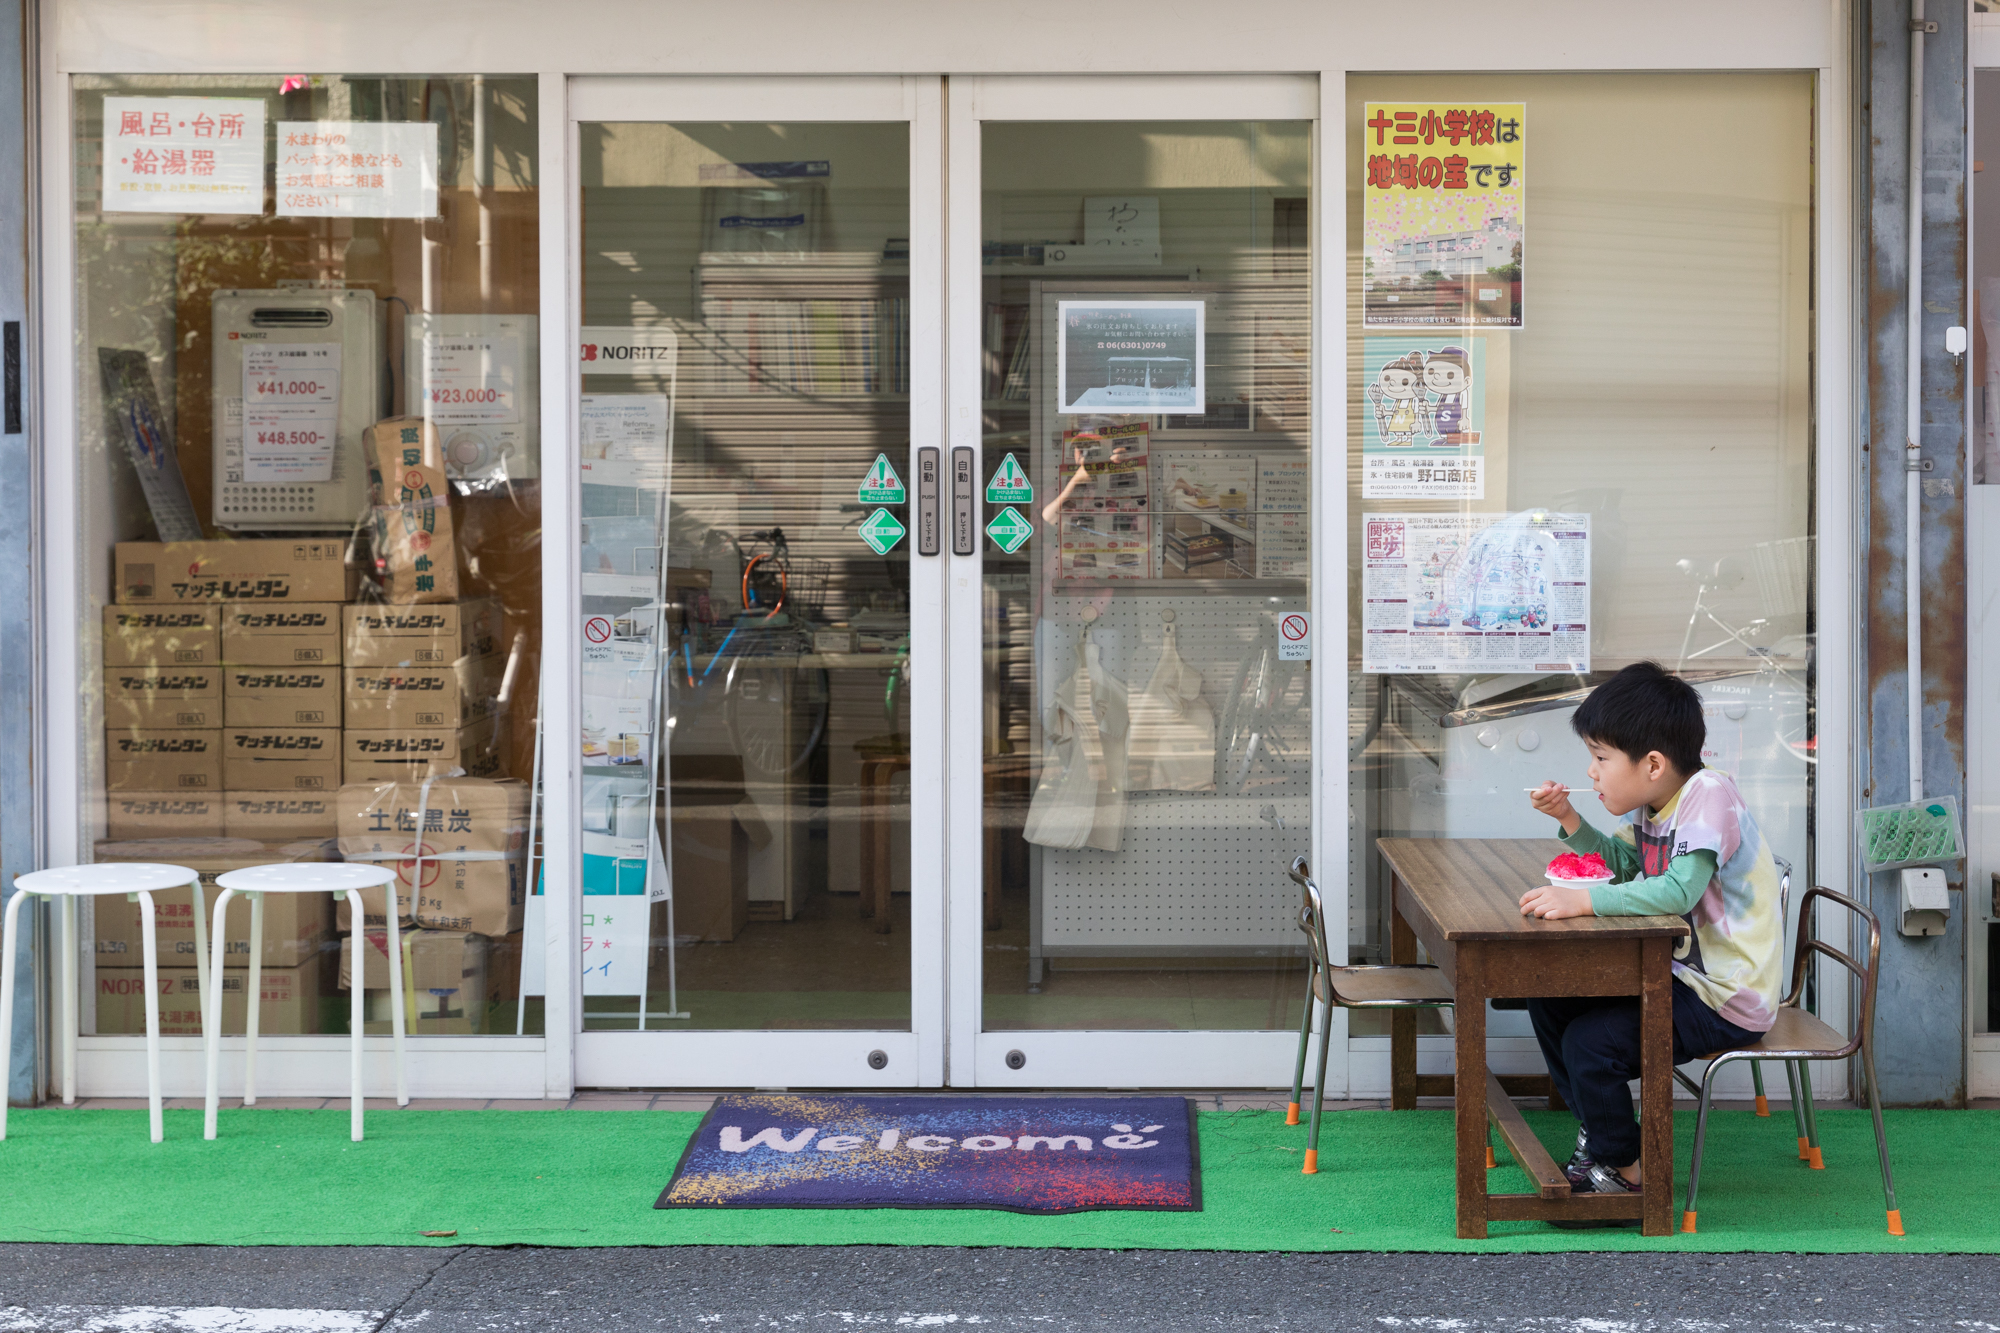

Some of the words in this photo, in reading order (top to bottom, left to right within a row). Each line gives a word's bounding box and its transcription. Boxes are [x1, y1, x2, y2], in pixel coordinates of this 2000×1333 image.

[119, 110, 245, 139] 風呂・台所
[1367, 109, 1521, 147] 十三小学校は
[285, 132, 346, 147] 水まわりの
[284, 153, 403, 168] パッキン交換なども
[1367, 153, 1518, 190] 地域の宝です
[285, 173, 385, 188] お気軽にご相談
[1106, 341, 1167, 350] 06(6301)0749
[602, 346, 668, 360] NORITZ
[1440, 410, 1452, 421] S
[1370, 459, 1434, 467] 台所・風呂・給湯器
[923, 460, 934, 483] 自動
[957, 460, 968, 483] 自動
[1370, 471, 1413, 479] 氷・住宅設備
[1417, 468, 1477, 483] 野口商店
[1370, 524, 1382, 550] 関西
[171, 579, 290, 598] マッチレンタン
[116, 614, 205, 627] マッチレンタン
[237, 613, 327, 627] マッチレンタン
[356, 615, 446, 629] マッチレンタン
[119, 676, 209, 690] マッチレンタン
[236, 675, 325, 688] マッチレンタン
[355, 677, 445, 691] マッチレンタン
[418, 714, 441, 723] 8個入
[118, 739, 208, 752] マッチレンタン
[234, 735, 324, 749] マッチレンタン
[356, 738, 445, 752] マッチレンタン
[121, 801, 209, 814] マッチレンタン
[237, 801, 326, 814] マッチレンタン
[368, 808, 472, 833] 土佐黒炭
[719, 1123, 1165, 1153] Welcome
